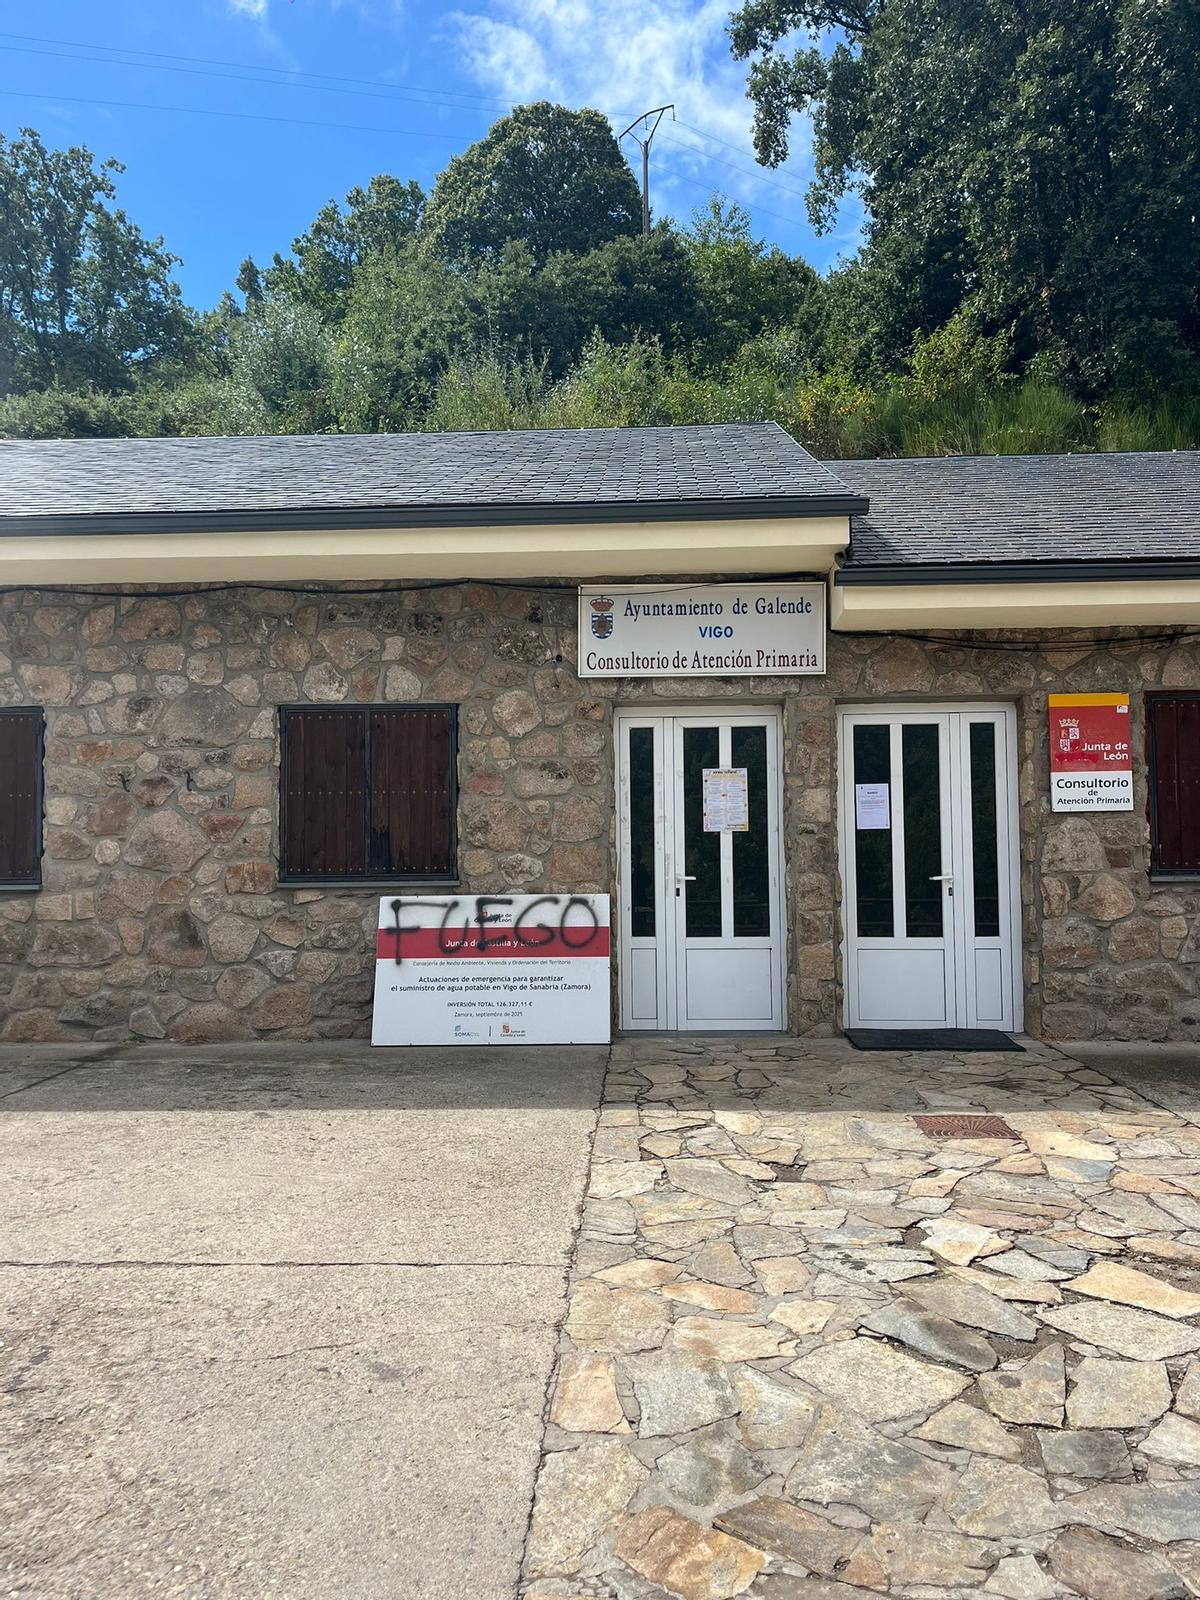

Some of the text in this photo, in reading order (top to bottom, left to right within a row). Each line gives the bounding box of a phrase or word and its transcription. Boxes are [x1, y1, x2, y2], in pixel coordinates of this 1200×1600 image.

[624, 597, 812, 621] Ayuntamiento de Galende
[699, 626, 734, 638] VIGO
[587, 649, 818, 670] Consultorio de Atención Primaria
[1082, 742, 1111, 751] Junta
[1104, 751, 1128, 760] León
[1057, 778, 1128, 788] Consultorio
[1057, 797, 1094, 805] Atención
[385, 897, 598, 966] FUEGO
[465, 984, 490, 992] potable
[561, 983, 591, 991] (Zamora)
